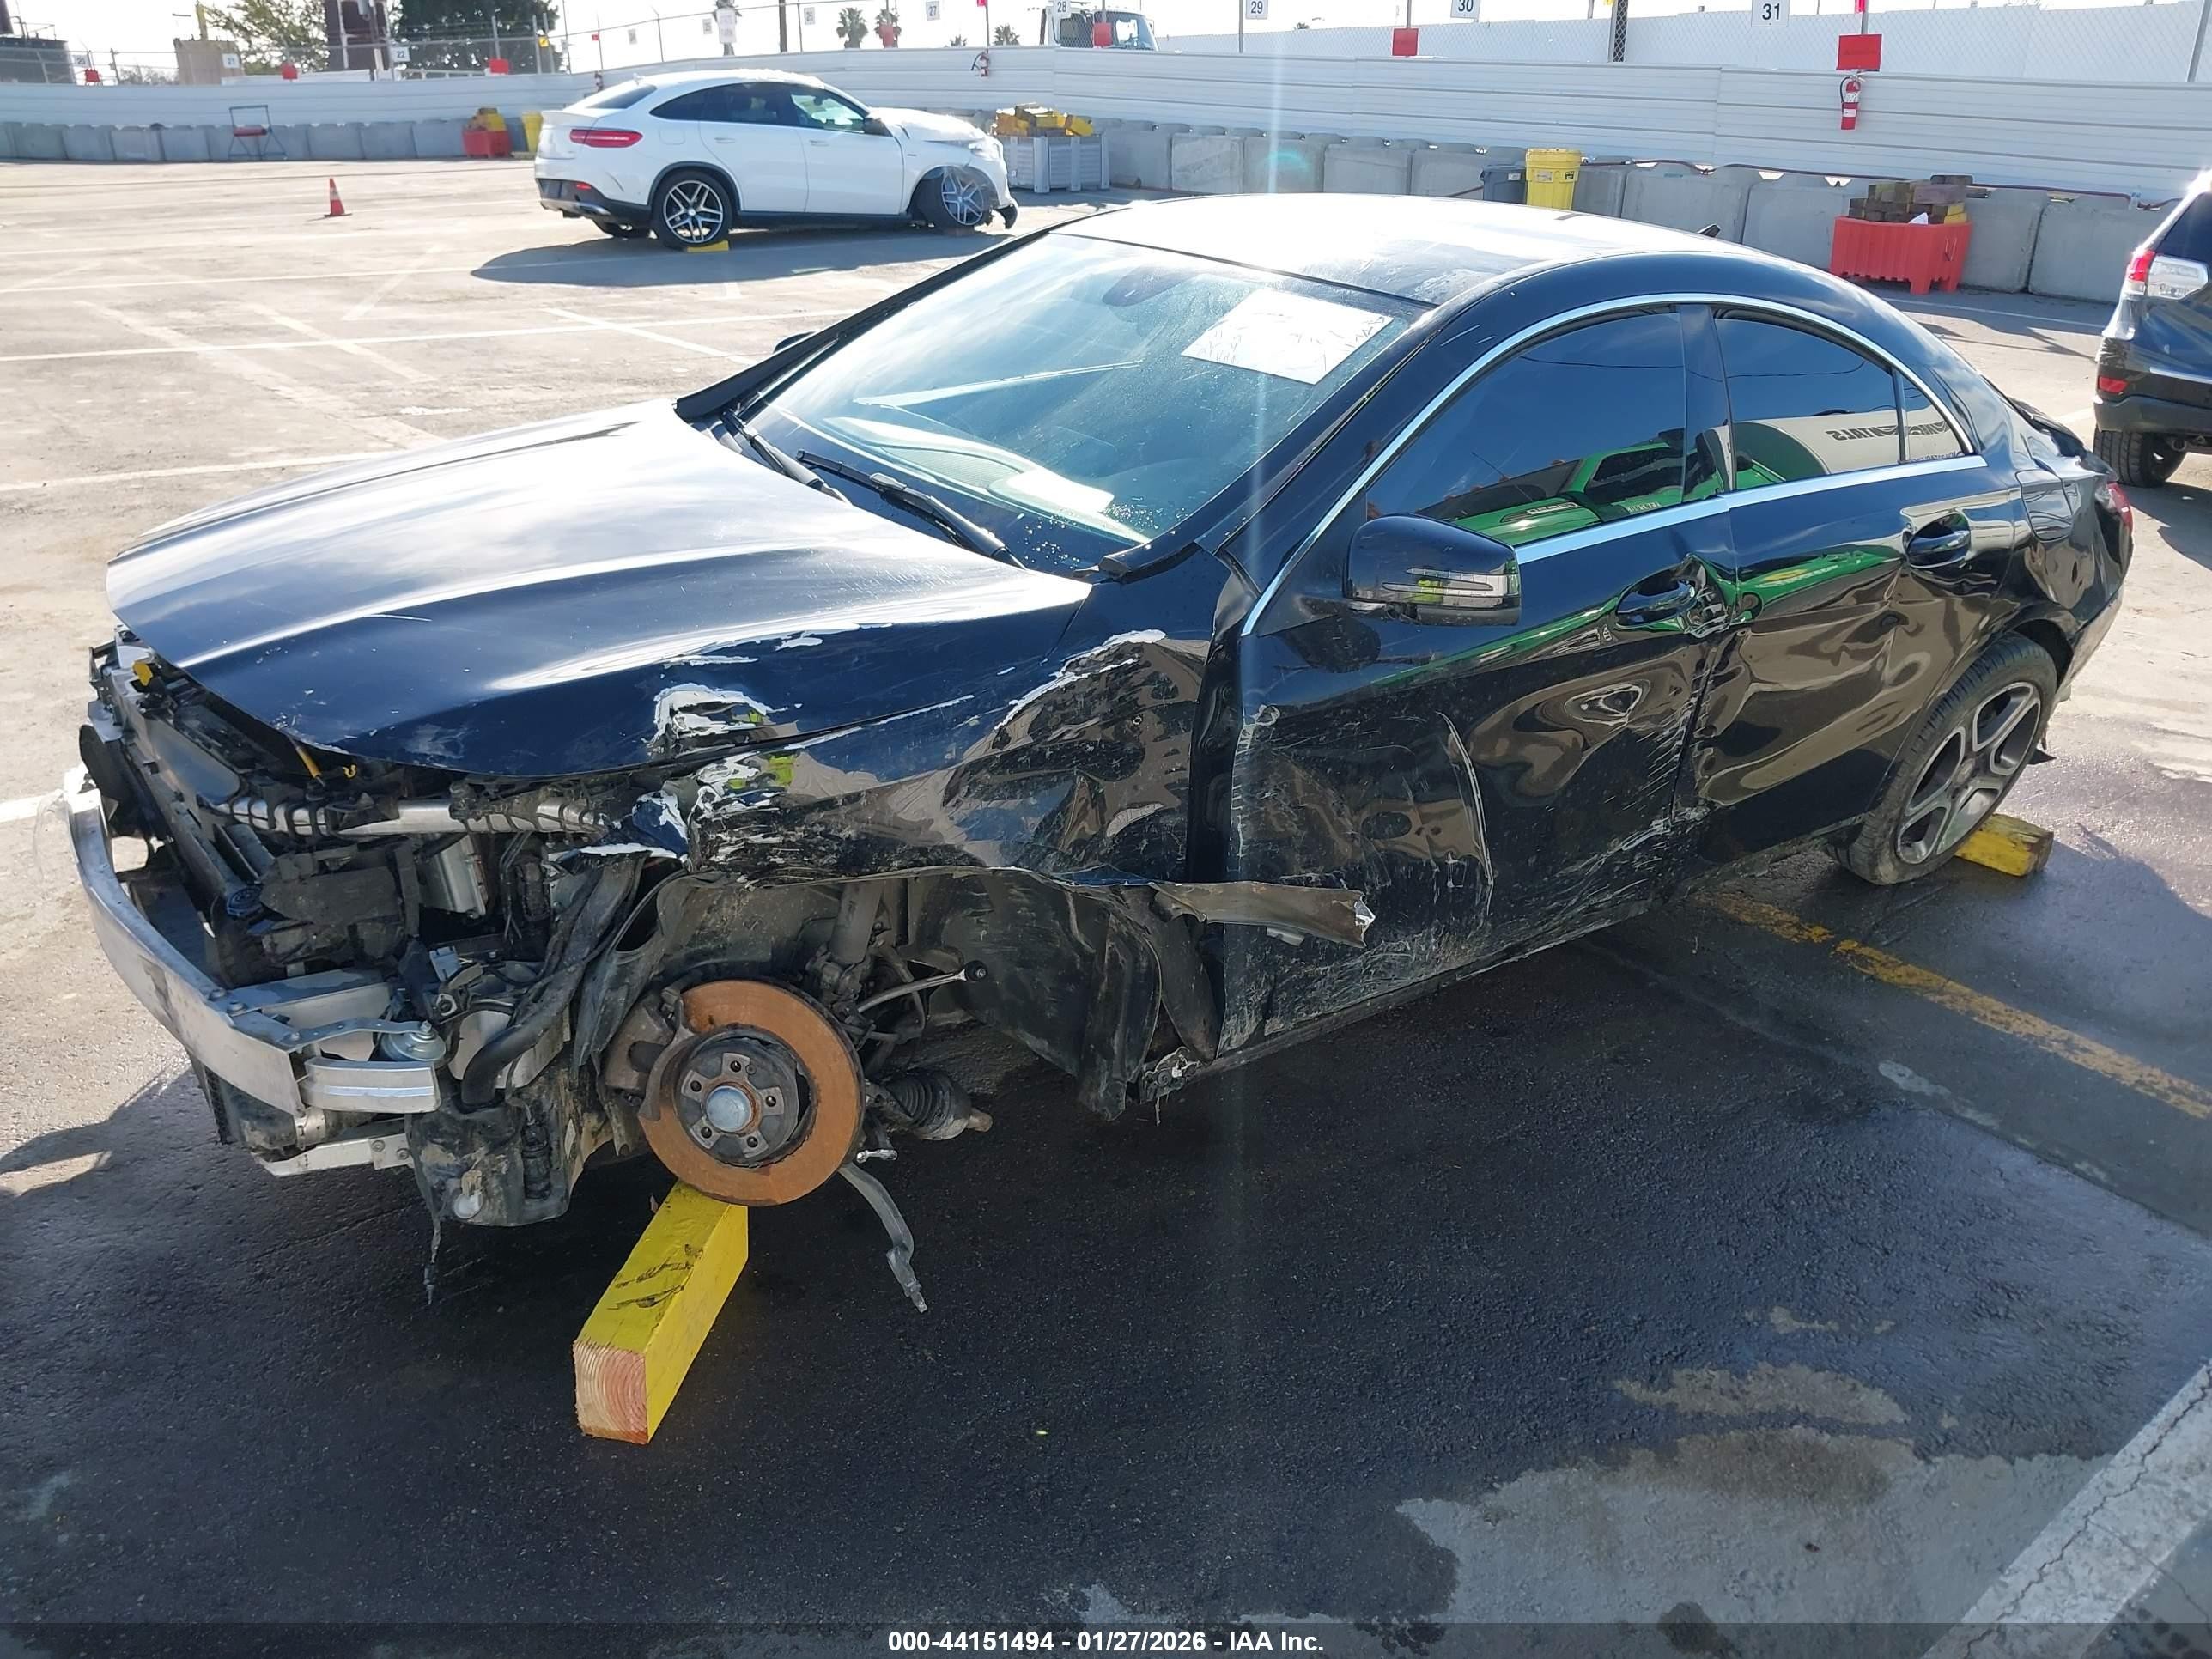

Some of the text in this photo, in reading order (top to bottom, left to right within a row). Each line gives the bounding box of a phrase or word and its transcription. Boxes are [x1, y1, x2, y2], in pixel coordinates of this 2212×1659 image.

[928, 5, 937, 17] 27
[1056, 1, 1067, 13] 28
[1251, 1, 1263, 14] 29
[1458, 0, 1474, 12] 30
[1762, 3, 1780, 20] 31
